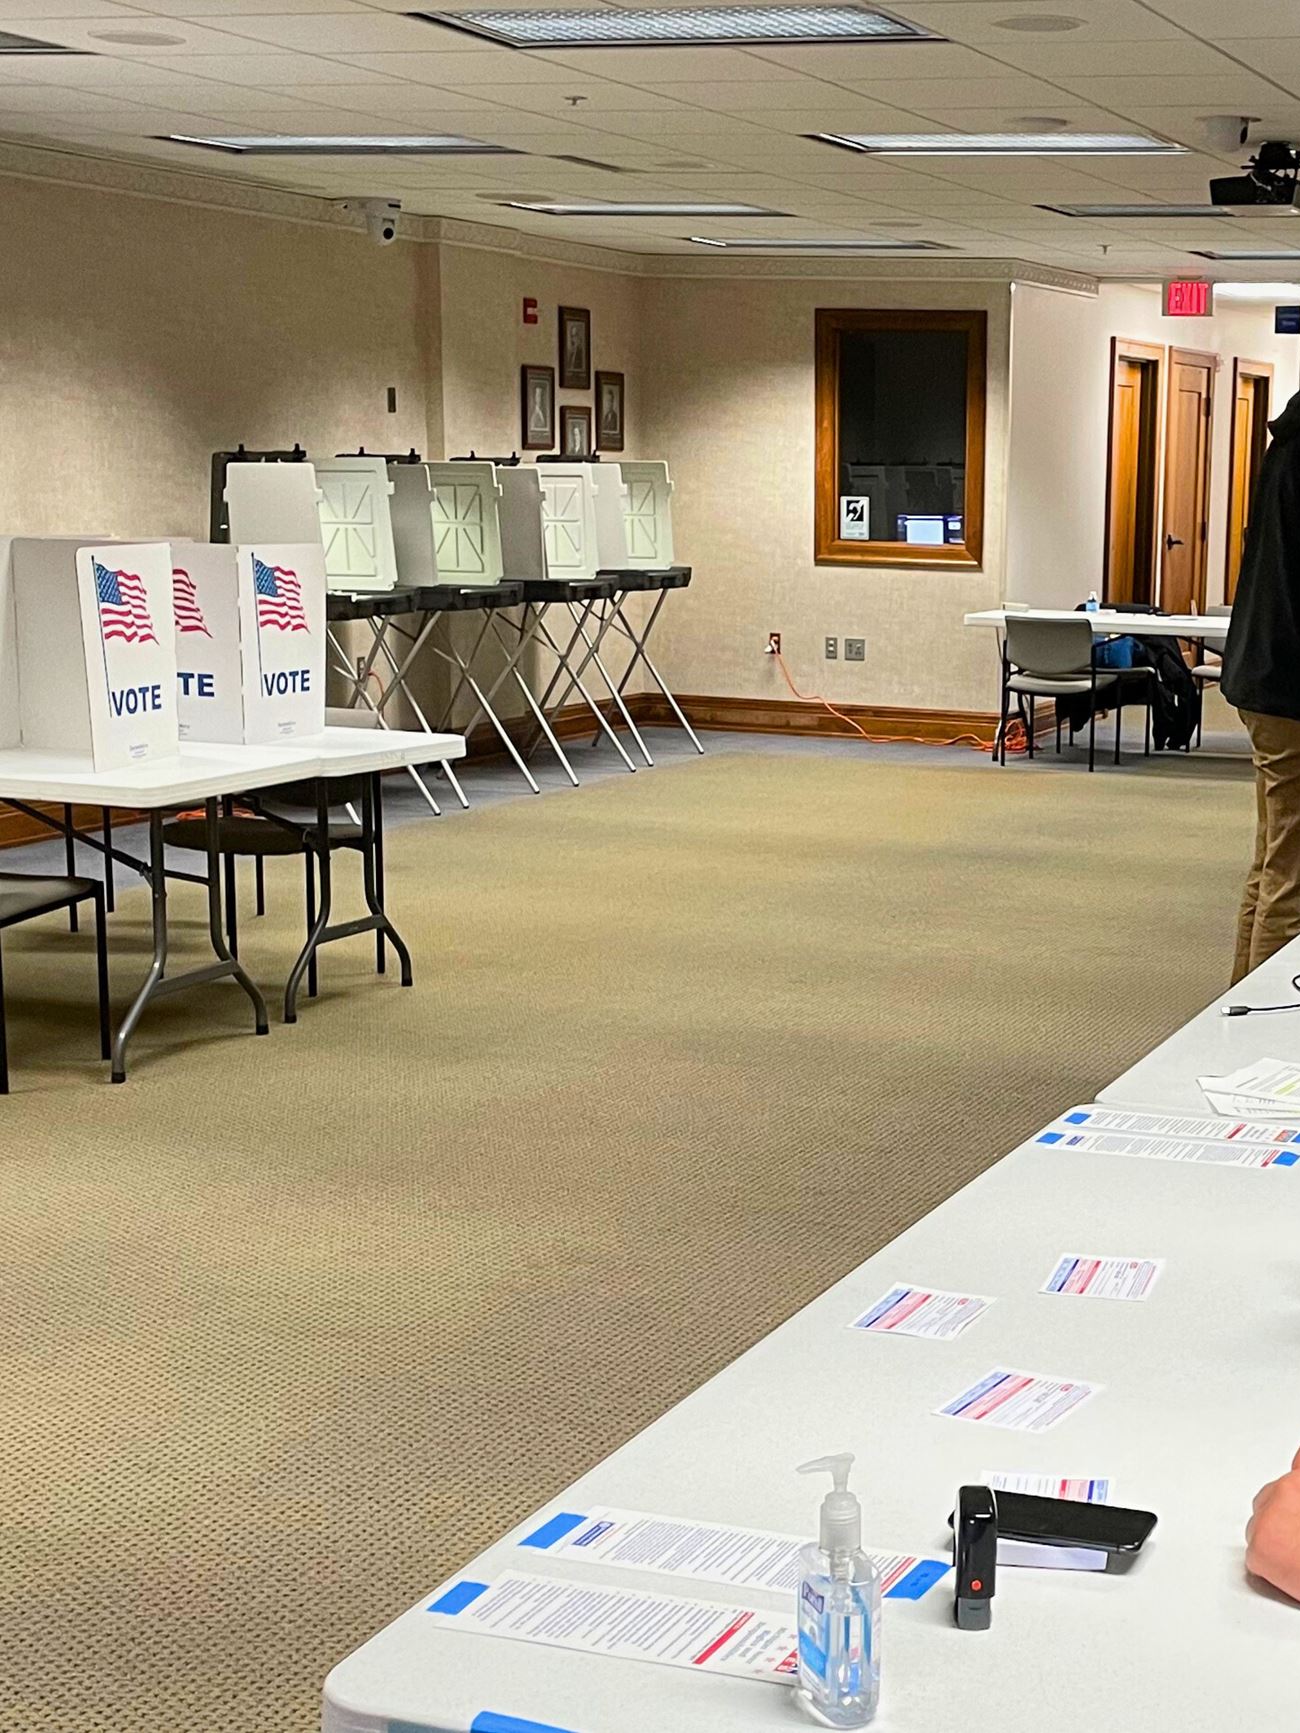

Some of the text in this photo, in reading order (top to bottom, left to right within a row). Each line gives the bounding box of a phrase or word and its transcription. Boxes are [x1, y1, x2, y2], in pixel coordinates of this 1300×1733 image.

[1168, 281, 1208, 315] EXIT
[176, 671, 215, 697] TE
[263, 669, 311, 697] VOTE
[111, 684, 162, 717] VOTE
